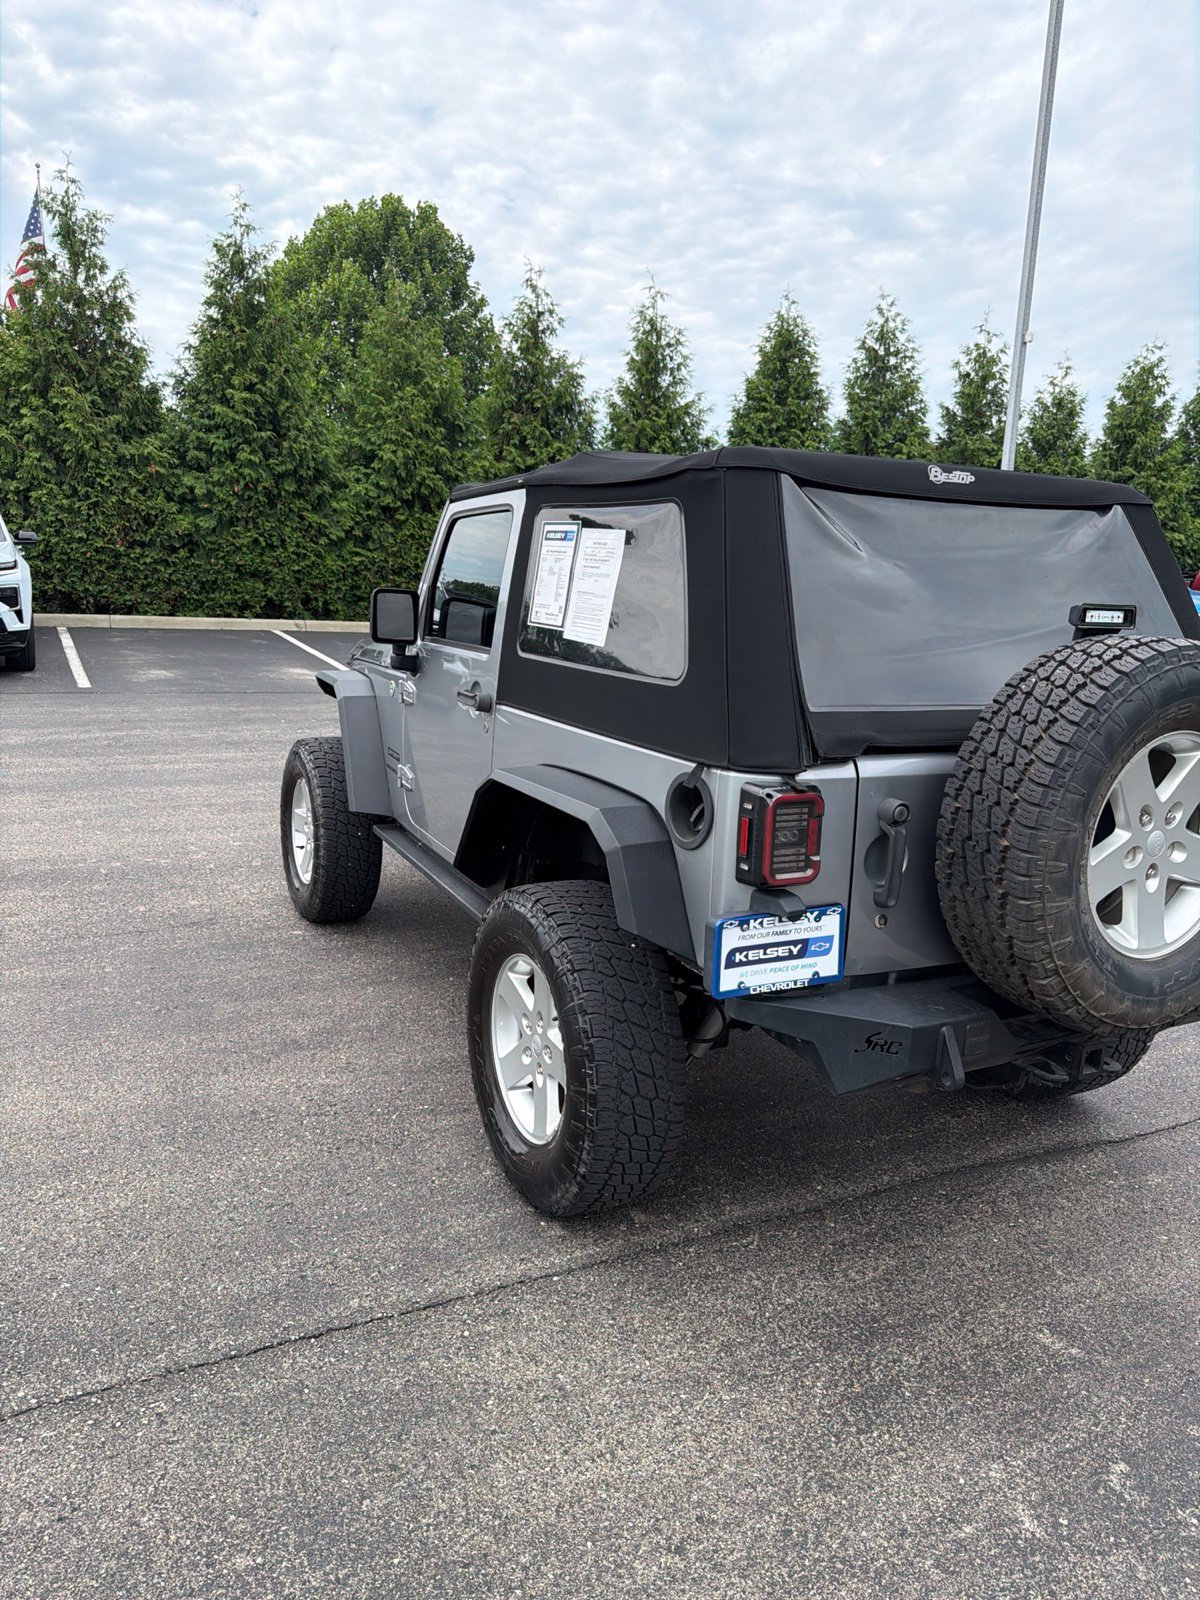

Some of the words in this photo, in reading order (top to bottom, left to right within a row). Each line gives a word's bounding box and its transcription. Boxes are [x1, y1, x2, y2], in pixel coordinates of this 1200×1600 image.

[737, 933, 757, 942] FROM
[756, 931, 770, 939] OUR
[770, 928, 793, 937] FAMILY
[793, 927, 803, 935] TO
[803, 924, 823, 933] YOURS
[735, 944, 803, 962] KELSEY
[750, 967, 768, 976] DRIVE
[768, 964, 789, 974] PEACE
[790, 963, 800, 971] OF
[800, 961, 818, 969] MIND
[750, 979, 810, 994] CHEVROLET
